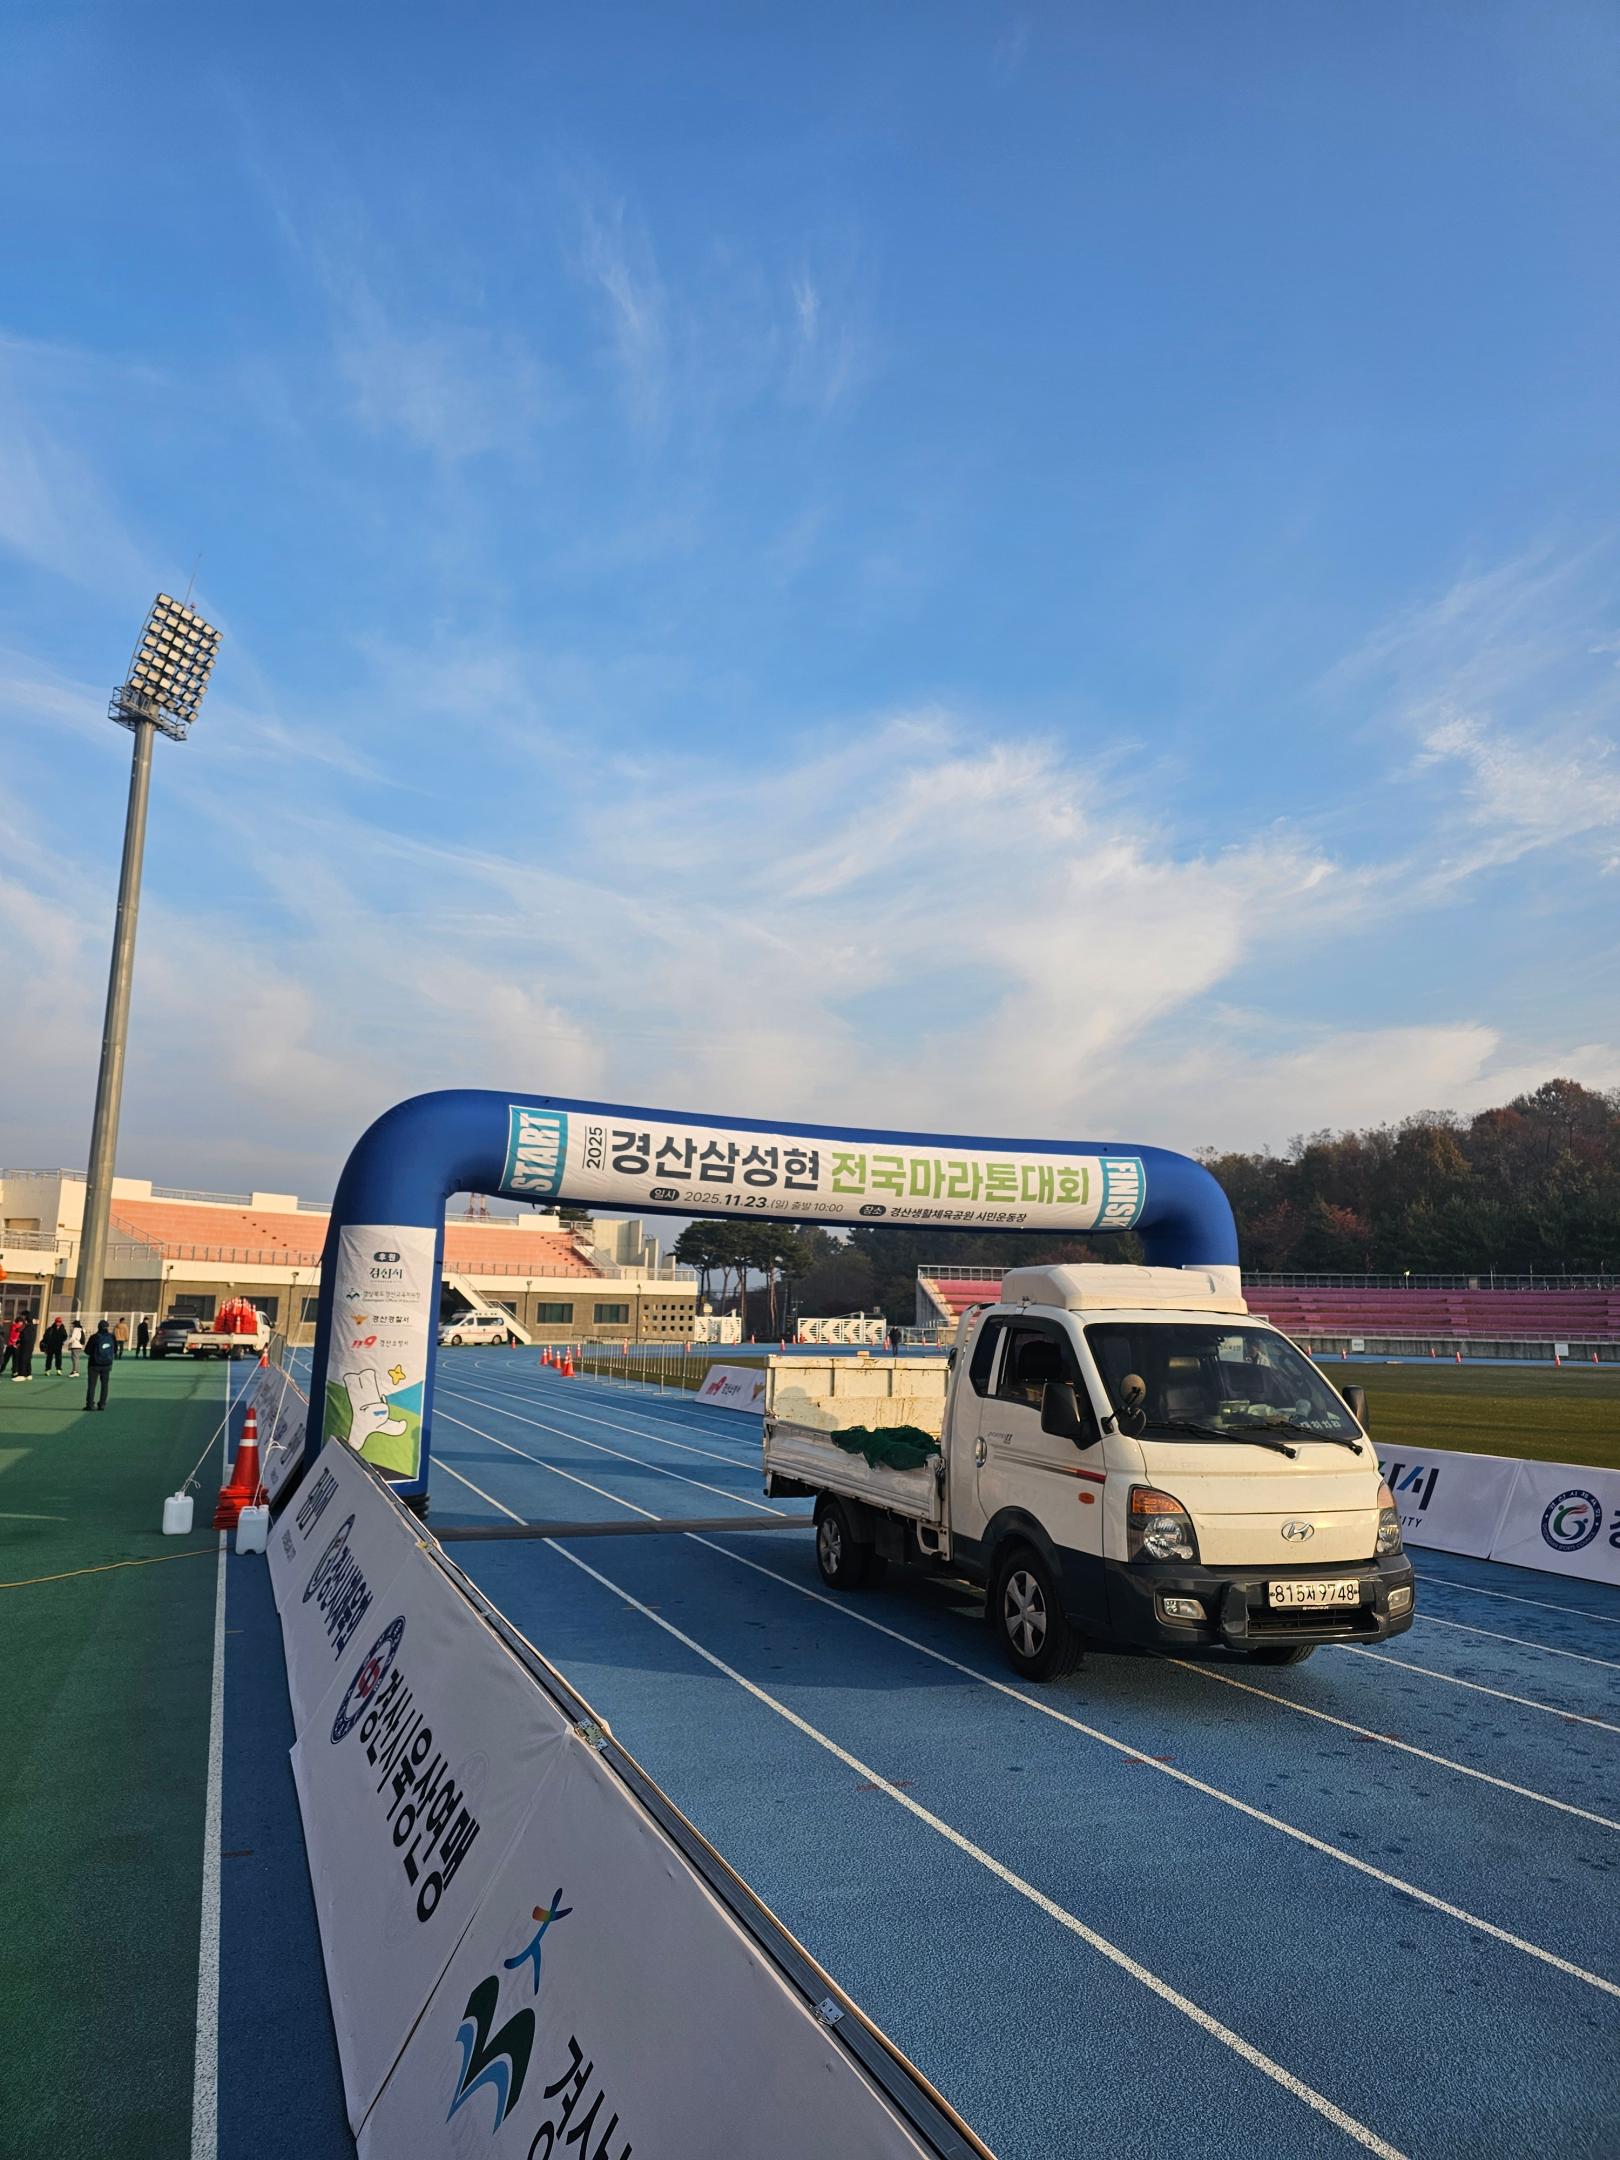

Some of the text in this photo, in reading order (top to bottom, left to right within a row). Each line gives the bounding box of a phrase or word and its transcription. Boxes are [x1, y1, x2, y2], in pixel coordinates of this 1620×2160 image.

[510, 1113, 560, 1192] START
[587, 1127, 603, 1169] 2025
[611, 1130, 1090, 1206] 경산삼성현 전국마라톤대회
[653, 1188, 677, 1200] 일시
[814, 1202, 844, 1213] 10:00
[862, 1205, 1028, 1223] 장소 경산생활체육공원 시민운동장
[1099, 1162, 1139, 1229] FINISH
[369, 1267, 403, 1280] 경산시
[1399, 1515, 1423, 1528] ITY
[359, 1668, 481, 1923] 경산시육상연맹
